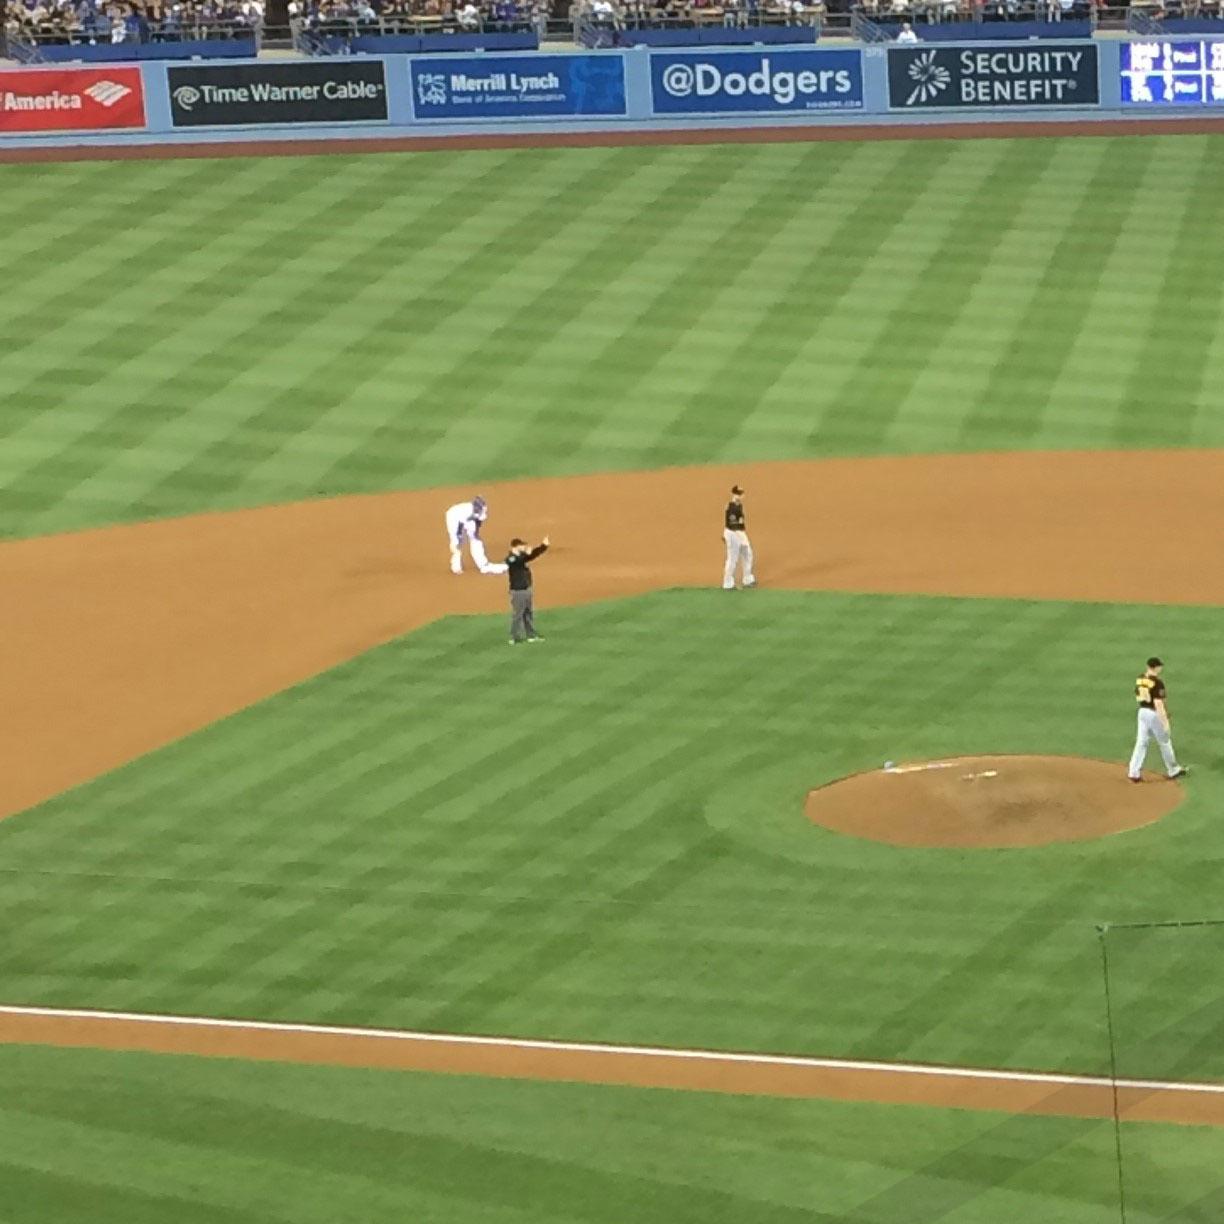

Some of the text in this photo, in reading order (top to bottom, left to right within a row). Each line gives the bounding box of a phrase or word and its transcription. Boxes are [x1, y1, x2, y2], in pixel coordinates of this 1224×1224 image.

[960, 50, 1082, 74] SECURITY
[200, 80, 378, 103] Time Warner Cable
[451, 72, 559, 92] Merrill Lynch
[662, 58, 852, 104] @Dodgers
[4, 91, 82, 110] America
